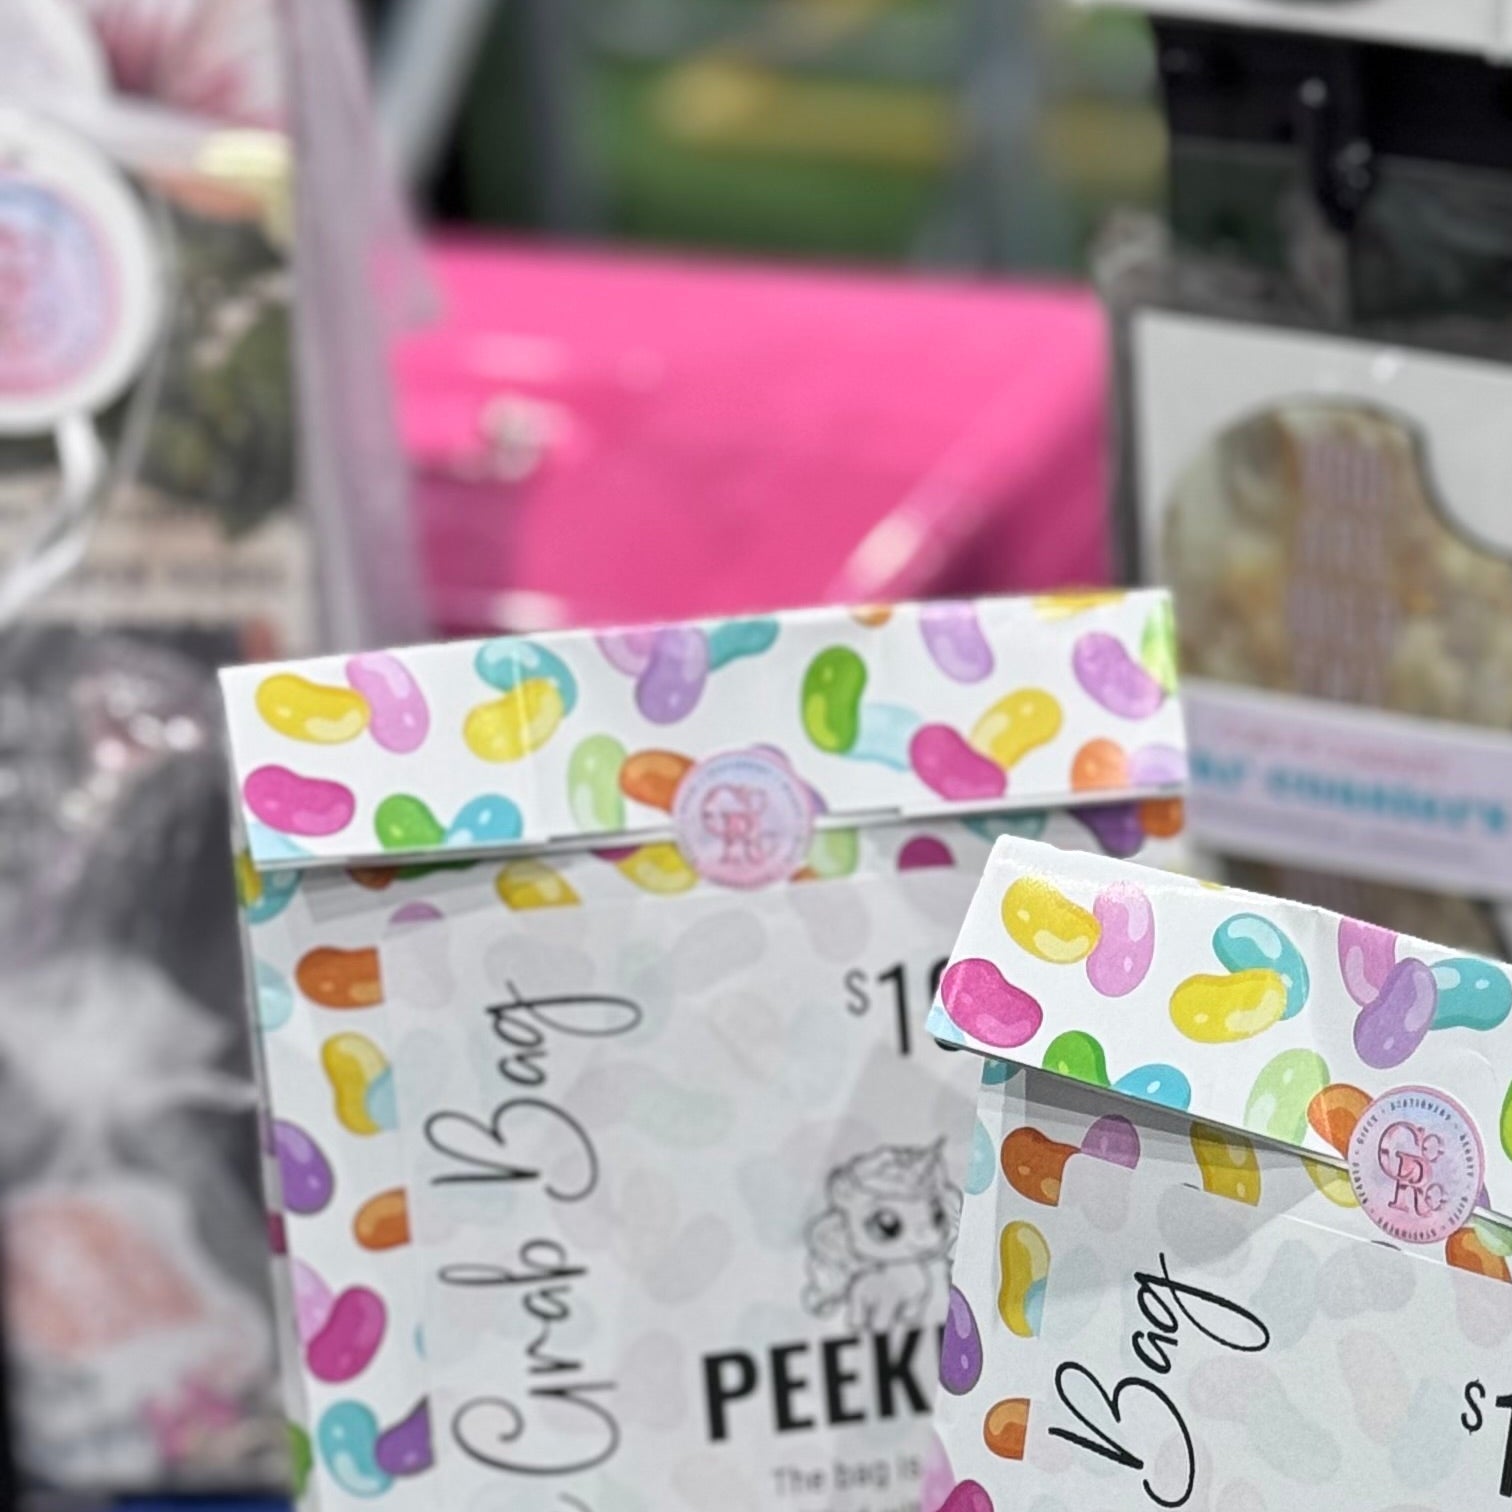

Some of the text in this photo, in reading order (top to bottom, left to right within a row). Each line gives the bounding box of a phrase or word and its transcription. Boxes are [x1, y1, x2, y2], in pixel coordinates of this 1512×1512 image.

[424, 979, 643, 1203] Bag
[438, 1236, 622, 1477] Grab
[1048, 1252, 1270, 1508] Bag
